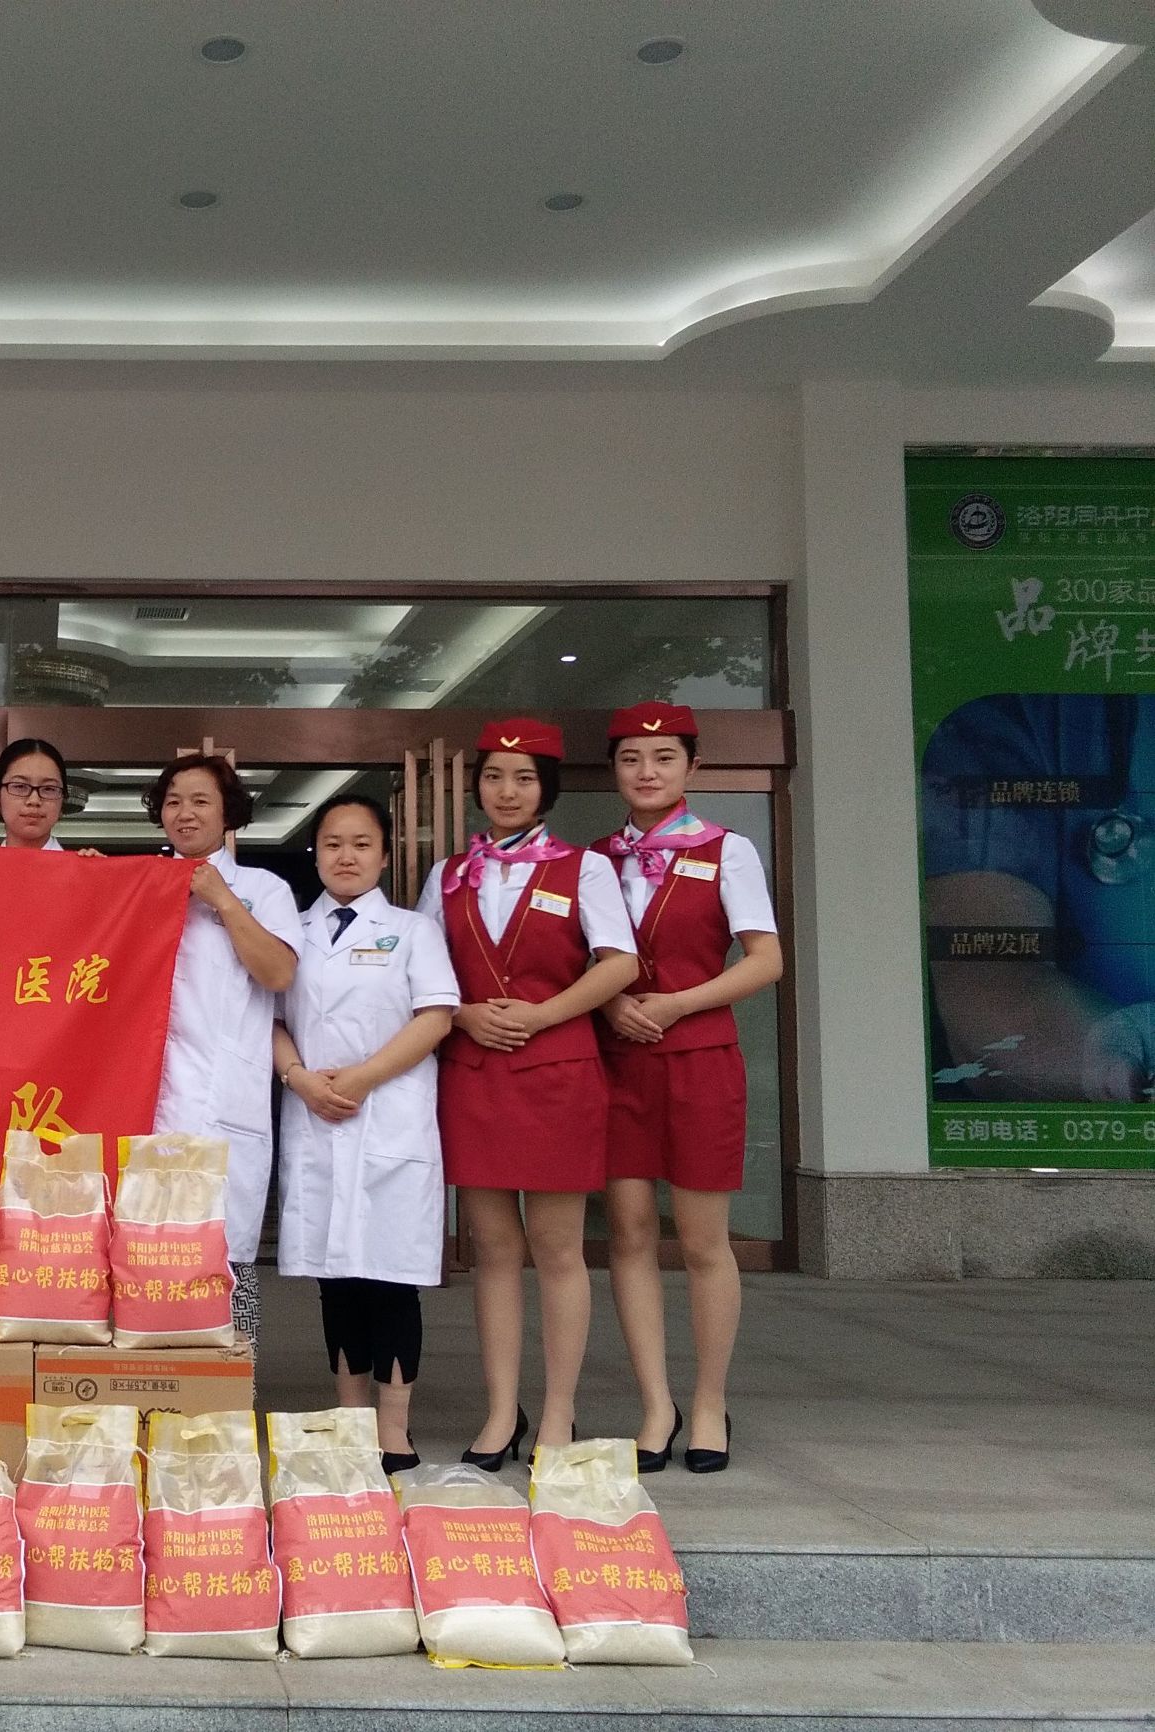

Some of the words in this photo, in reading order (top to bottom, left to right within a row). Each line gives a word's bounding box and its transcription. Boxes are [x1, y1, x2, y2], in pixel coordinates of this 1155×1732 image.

[990, 781, 1081, 803] 品牌连锁
[950, 931, 1041, 956] 品牌发展
